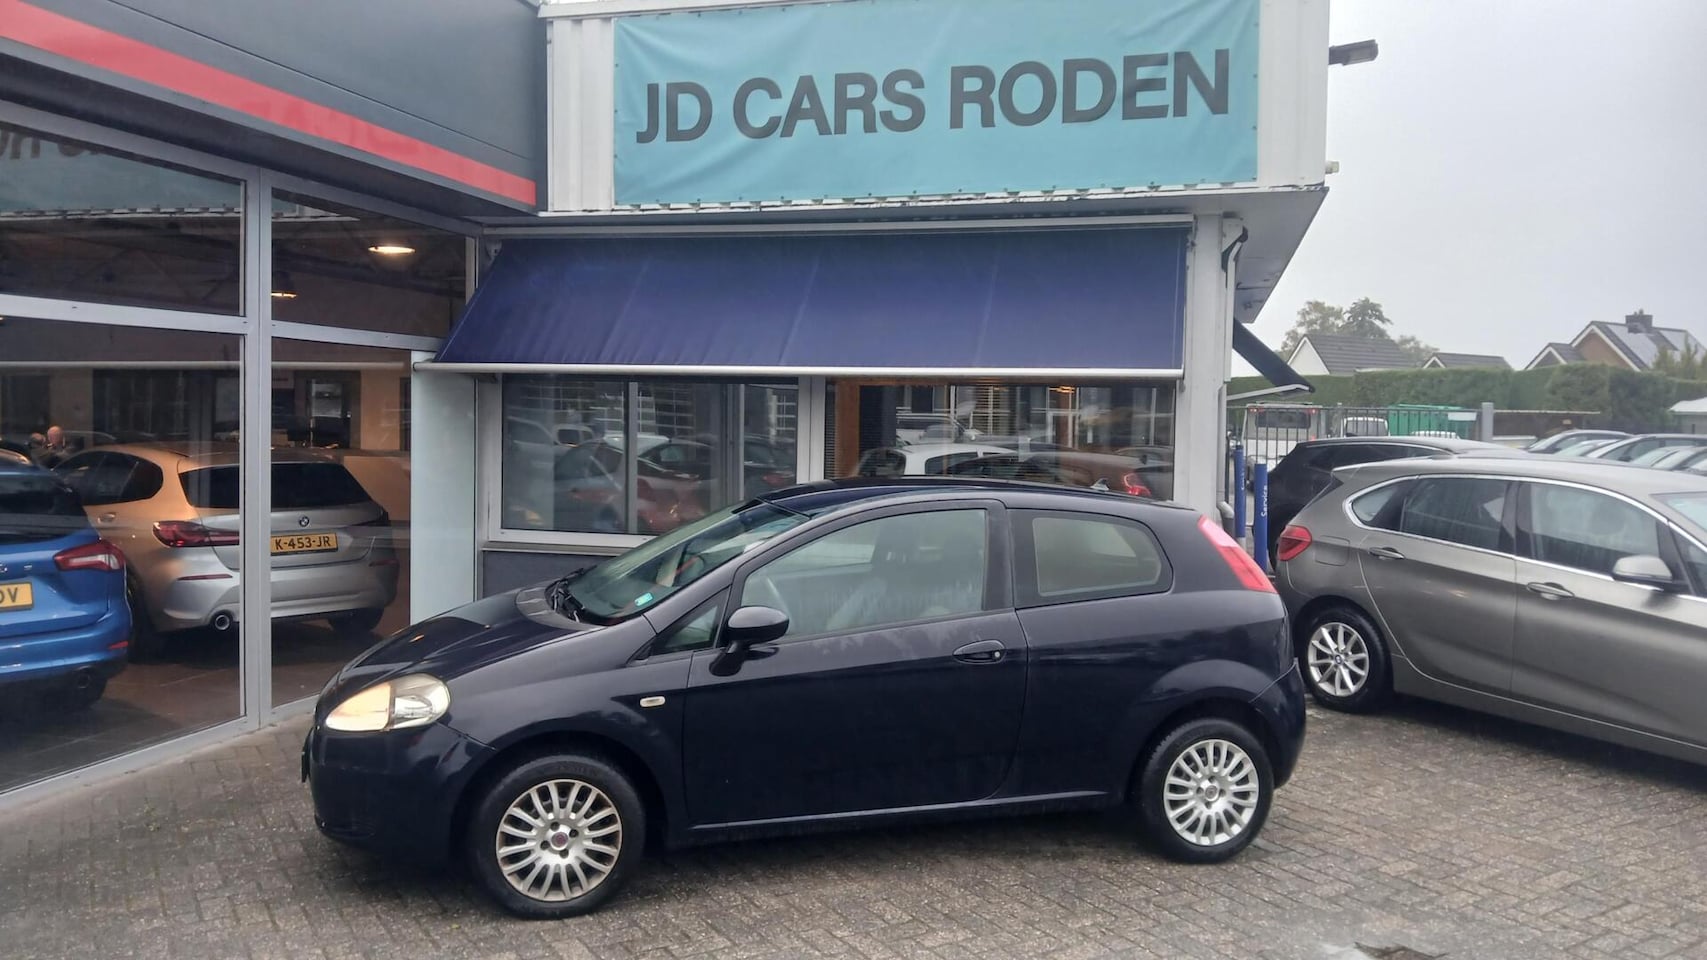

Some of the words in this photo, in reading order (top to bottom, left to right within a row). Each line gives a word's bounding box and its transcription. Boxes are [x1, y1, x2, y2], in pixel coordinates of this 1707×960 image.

[636, 81, 713, 144] JD
[732, 68, 926, 140] CARS
[949, 48, 1230, 130] RODEN
[274, 535, 332, 551] K-453-JR
